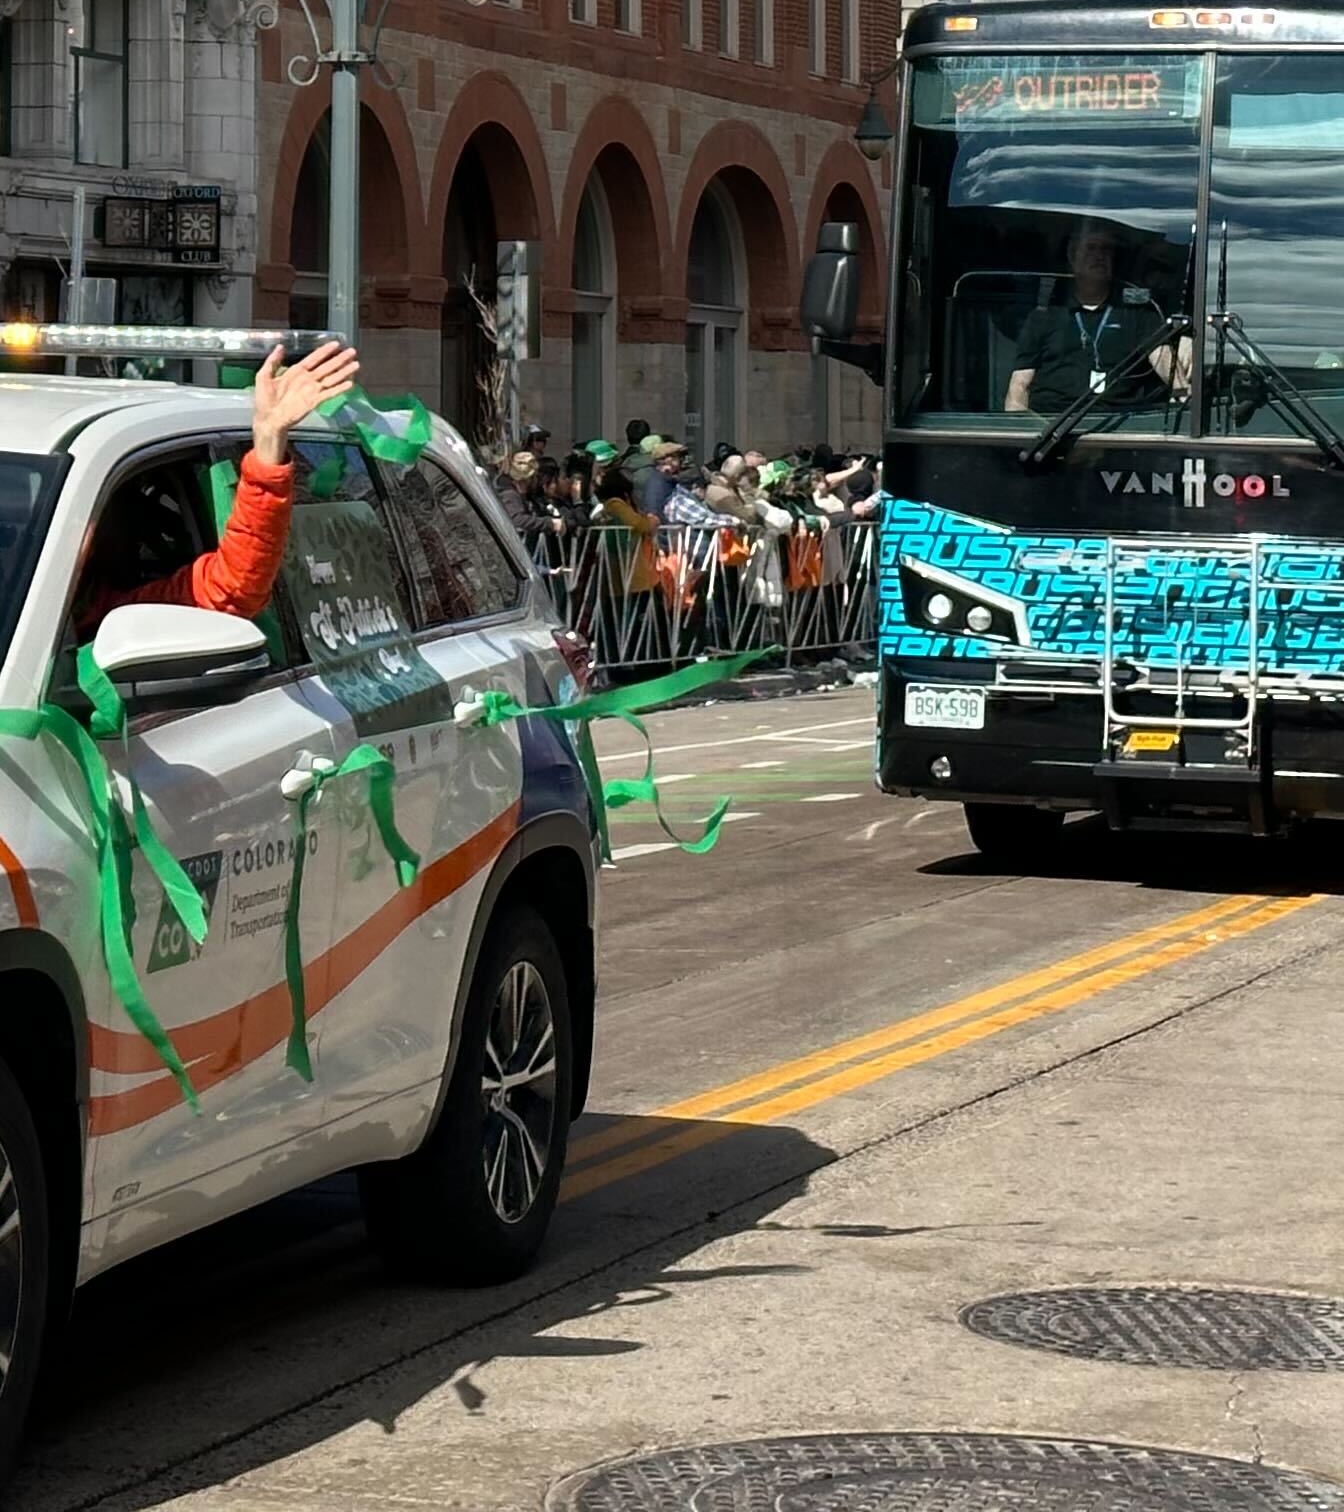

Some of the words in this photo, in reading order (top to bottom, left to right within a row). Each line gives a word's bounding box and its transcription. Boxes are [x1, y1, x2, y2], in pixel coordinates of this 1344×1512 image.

[1014, 73, 1161, 112] OUTRIDER
[232, 830, 319, 877] COLORAO
[158, 922, 183, 958] CO
